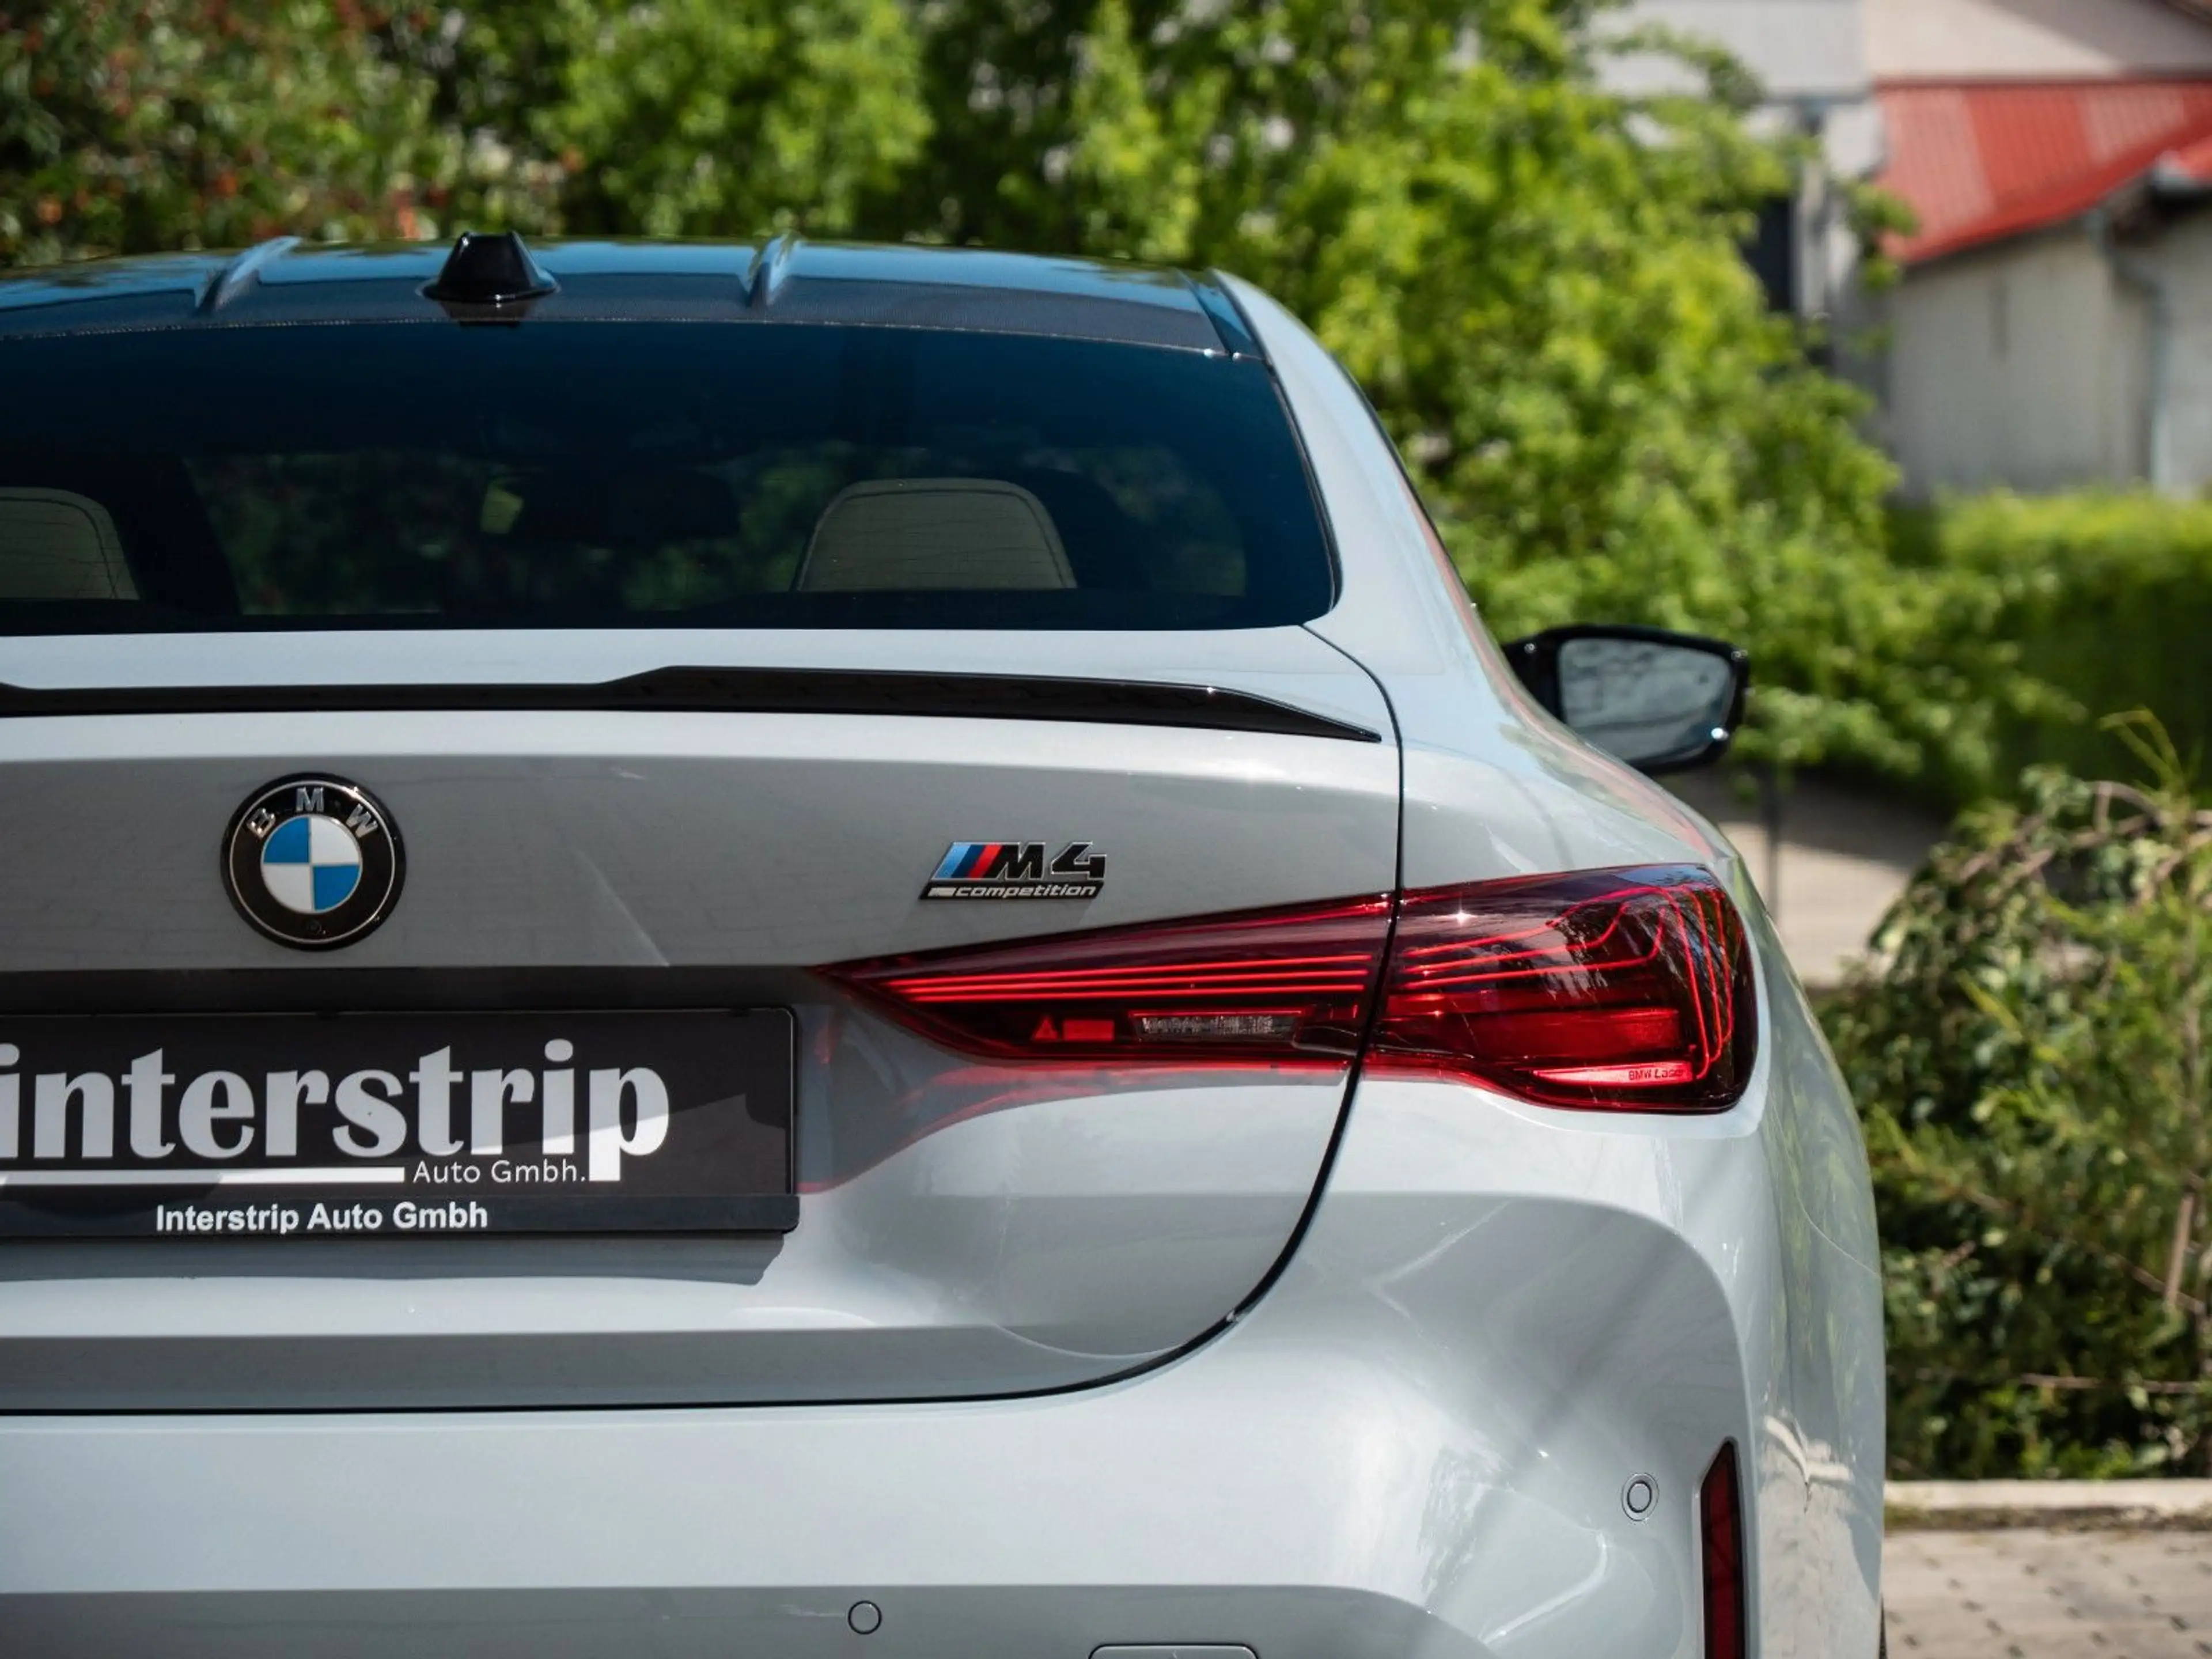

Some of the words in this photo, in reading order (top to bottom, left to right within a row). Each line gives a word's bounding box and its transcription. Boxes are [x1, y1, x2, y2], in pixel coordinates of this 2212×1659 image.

[247, 785, 378, 839] BMW
[982, 841, 1107, 880] M4
[955, 884, 1096, 899] competition
[1628, 1069, 1652, 1081] BMW
[0, 1039, 670, 1181] interstrip
[413, 1160, 481, 1184] Auto
[491, 1158, 586, 1183] Gmbh.
[156, 1203, 300, 1234] Interstrip
[306, 1202, 383, 1230] Auto
[392, 1201, 488, 1229] Gmbh
